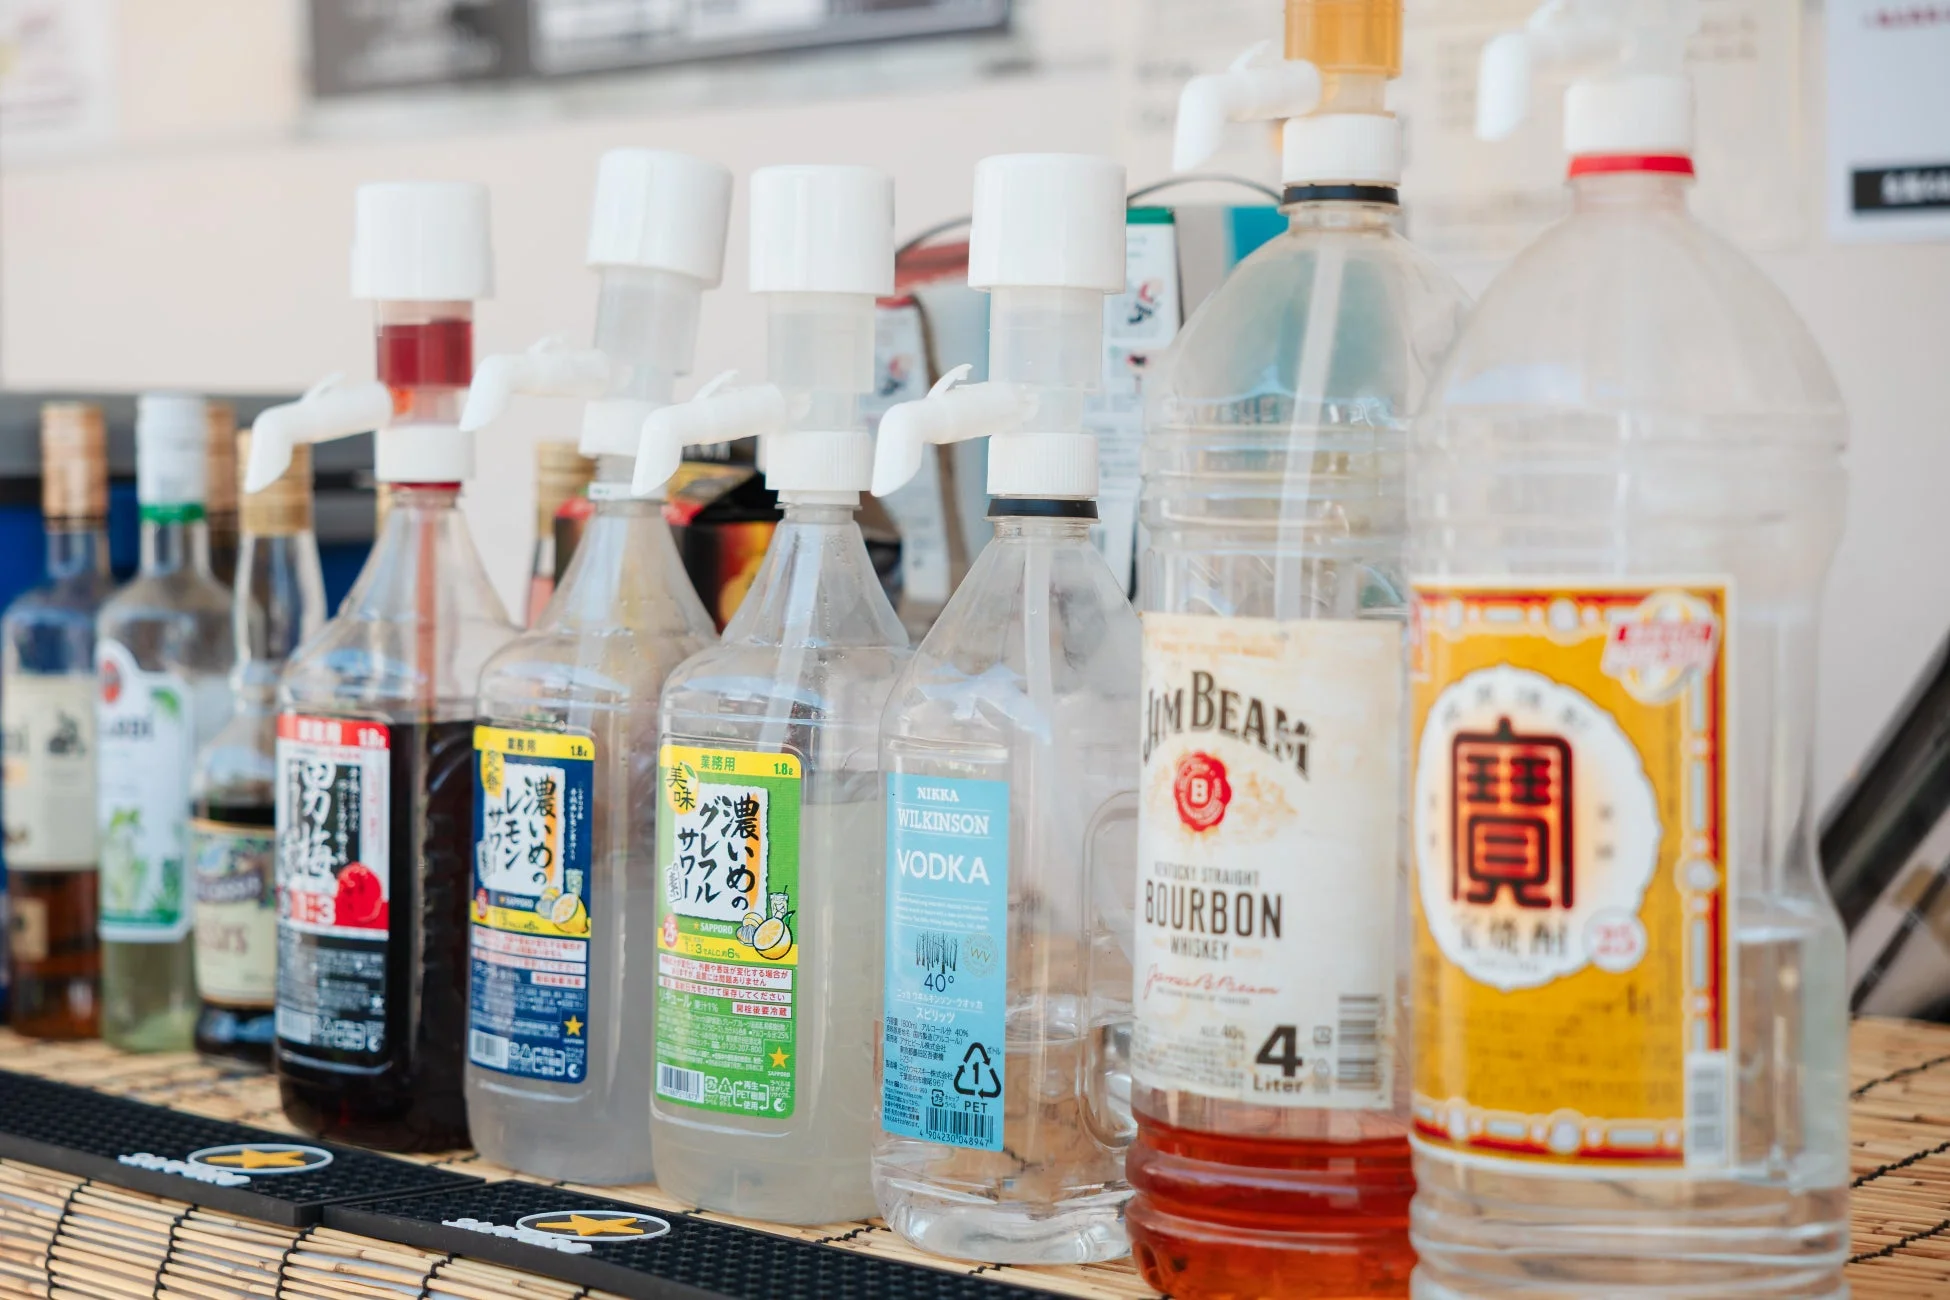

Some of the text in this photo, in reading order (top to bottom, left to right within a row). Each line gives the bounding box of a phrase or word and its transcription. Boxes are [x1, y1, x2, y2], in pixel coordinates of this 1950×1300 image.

[1190, 670, 1312, 780] BEAM
[701, 754, 736, 771] 業務用
[666, 762, 696, 811] 美味
[917, 786, 960, 802] NIKKA
[898, 808, 989, 835] WILKINSON
[695, 795, 722, 903] グレフル
[720, 792, 760, 910] 濃いめの
[678, 827, 699, 898] サワー
[896, 848, 991, 886] VODKA
[1201, 864, 1260, 888] STRAIGHT
[1145, 880, 1283, 939] BOURBON
[700, 922, 733, 934] SAPPORO
[1170, 935, 1229, 961] WHISKEY
[916, 1007, 956, 1024] スピリッツ
[1255, 1024, 1303, 1078] 4
[973, 1062, 980, 1085] 1
[1253, 1074, 1304, 1093] Liter
[964, 1100, 988, 1114] PET
